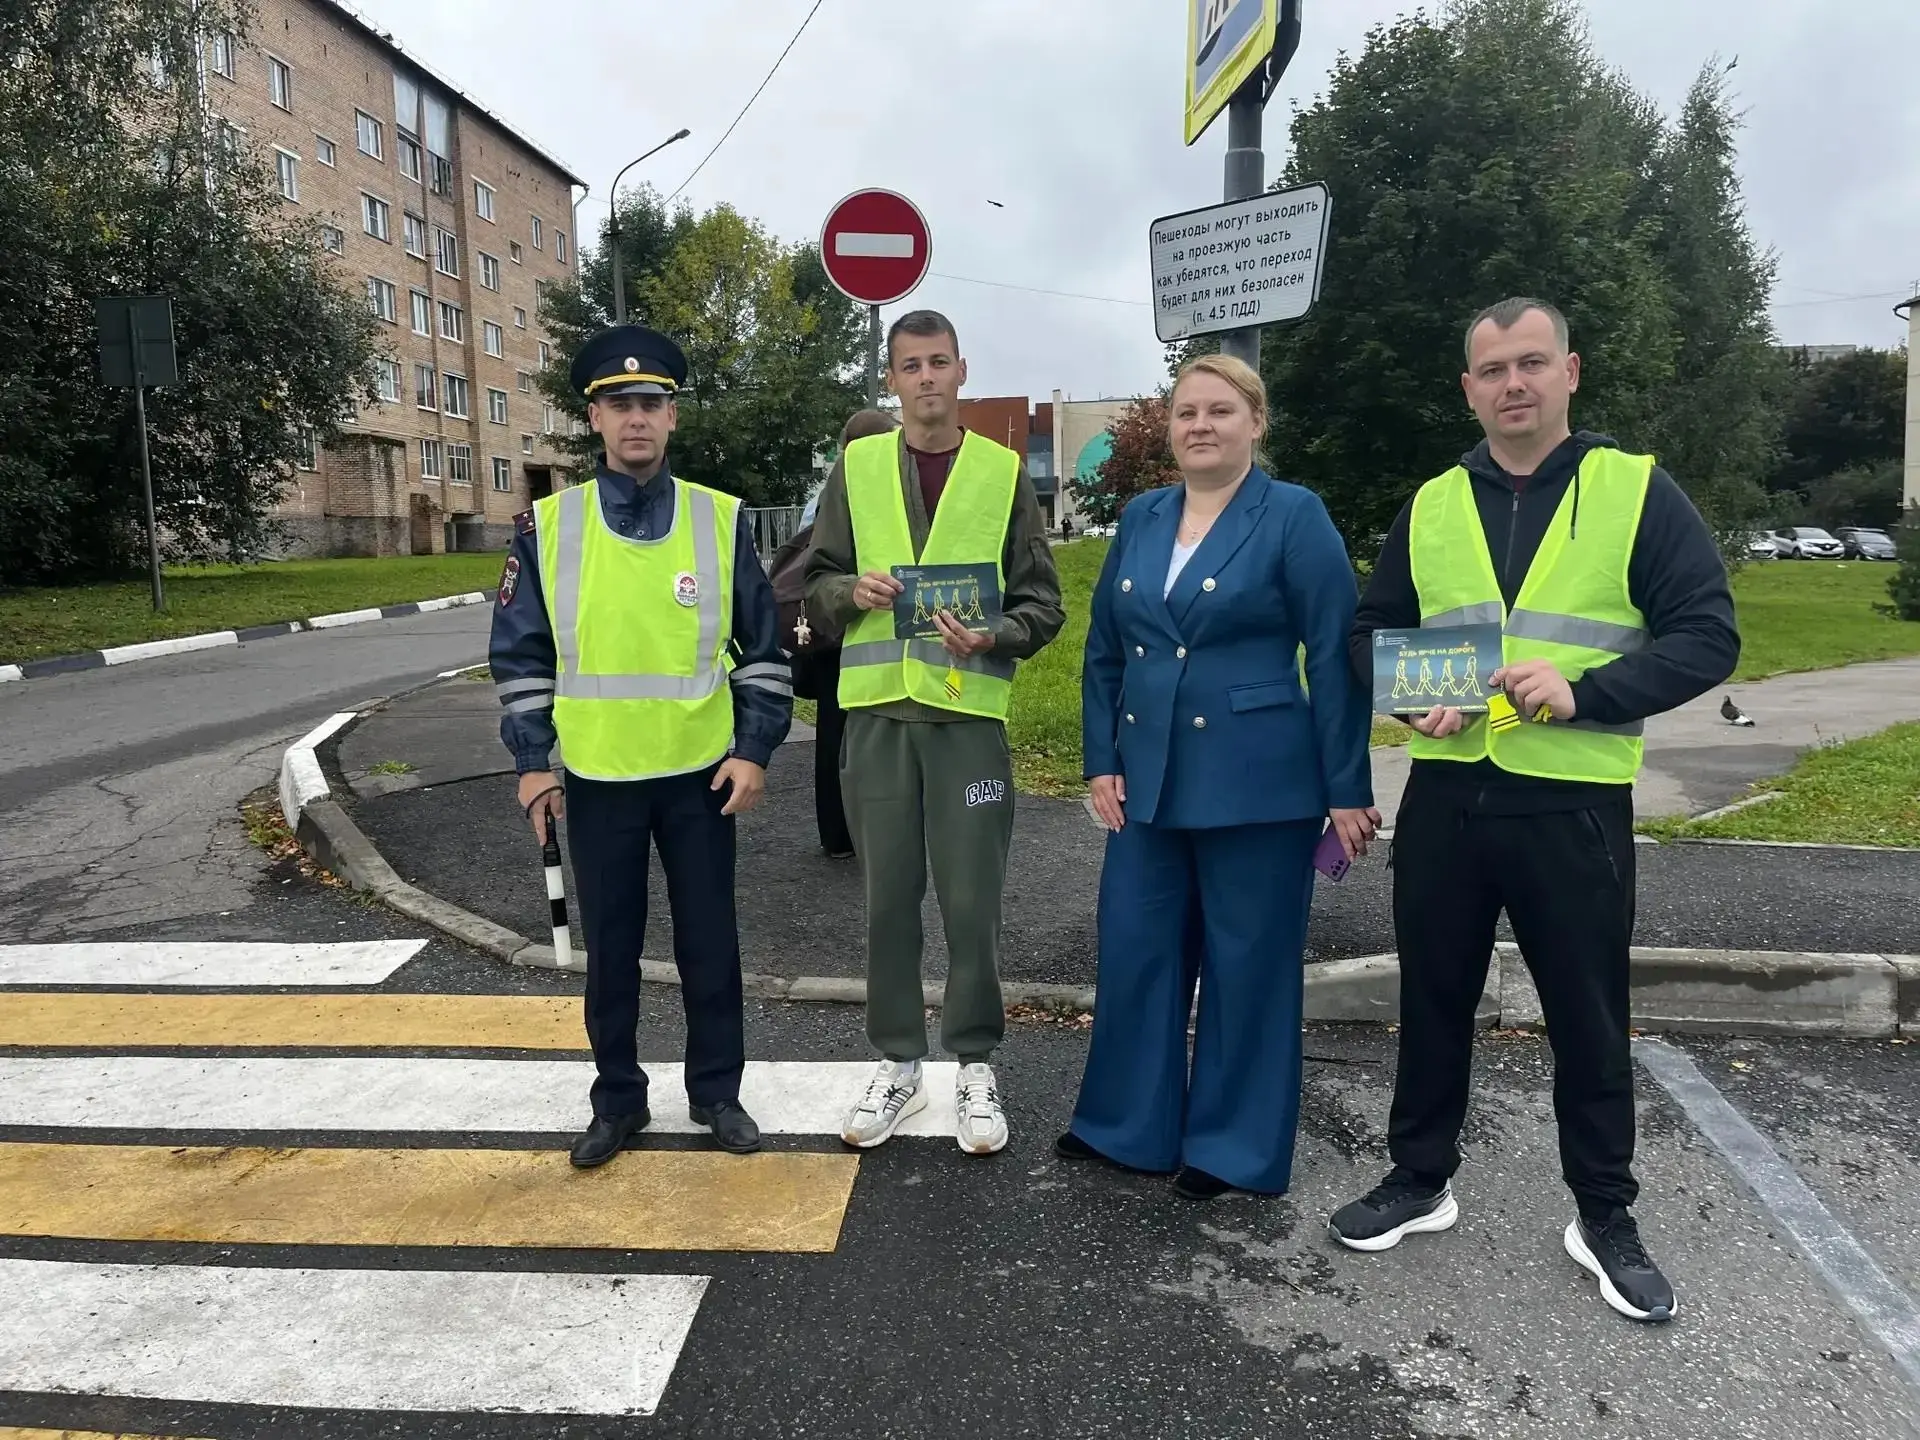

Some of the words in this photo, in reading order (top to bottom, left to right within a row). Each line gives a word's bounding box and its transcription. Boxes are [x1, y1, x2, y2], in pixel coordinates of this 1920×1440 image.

[1154, 222, 1211, 246] Пешеходы
[1215, 214, 1250, 233] могут
[1256, 200, 1319, 224] выходить
[1172, 250, 1185, 263] на
[1188, 236, 1251, 260] проезжую
[1256, 229, 1292, 246] часть
[1157, 273, 1173, 289] как
[1176, 264, 1230, 287] убедятся,
[1235, 258, 1256, 273] что
[1260, 247, 1312, 269] переход
[1161, 293, 1187, 311] будет
[1191, 288, 1211, 305] для
[1215, 284, 1236, 297] них
[1241, 271, 1305, 294] безопасен
[1192, 309, 1206, 327] (п.
[1209, 304, 1226, 321] 4.5
[1230, 299, 1261, 319] ПДД)
[1437, 648, 1447, 656] НА
[1448, 646, 1477, 655] ДОРОГЕ
[965, 780, 1005, 807] GAP
